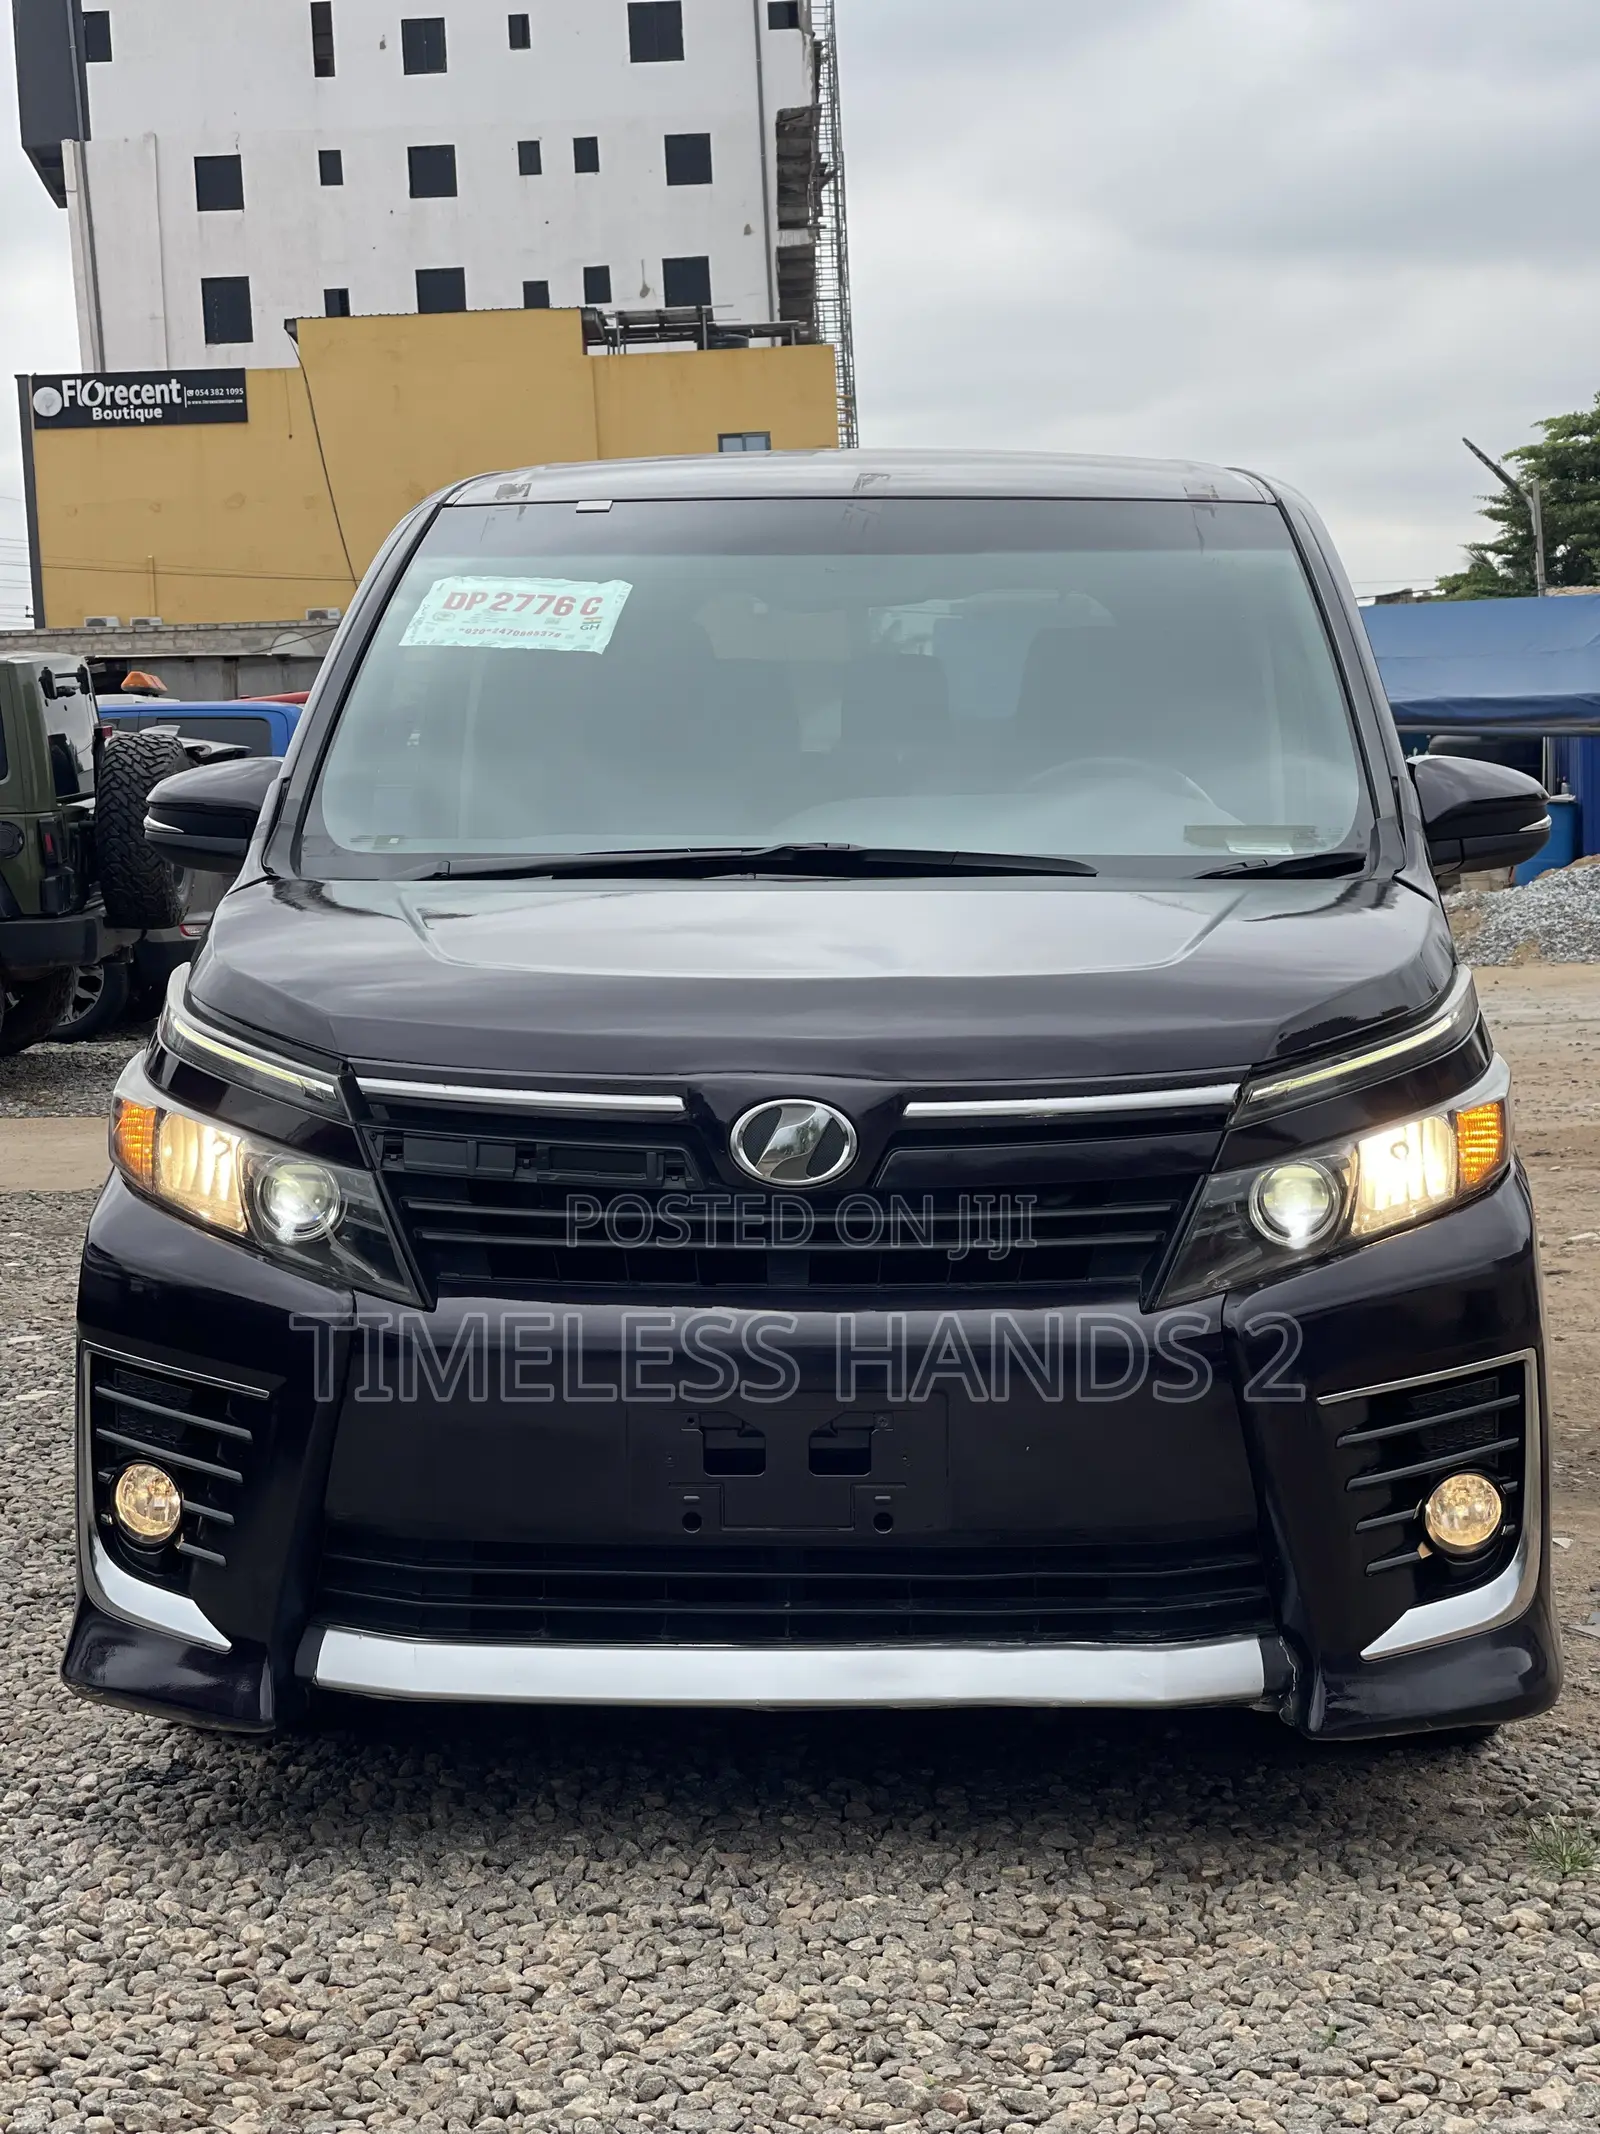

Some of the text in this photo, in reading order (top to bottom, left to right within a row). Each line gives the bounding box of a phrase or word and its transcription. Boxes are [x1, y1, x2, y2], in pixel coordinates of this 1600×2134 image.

[195, 387, 244, 397] 054 382 1095
[92, 405, 163, 423] Boutique
[442, 592, 604, 616] DP 2776 C
